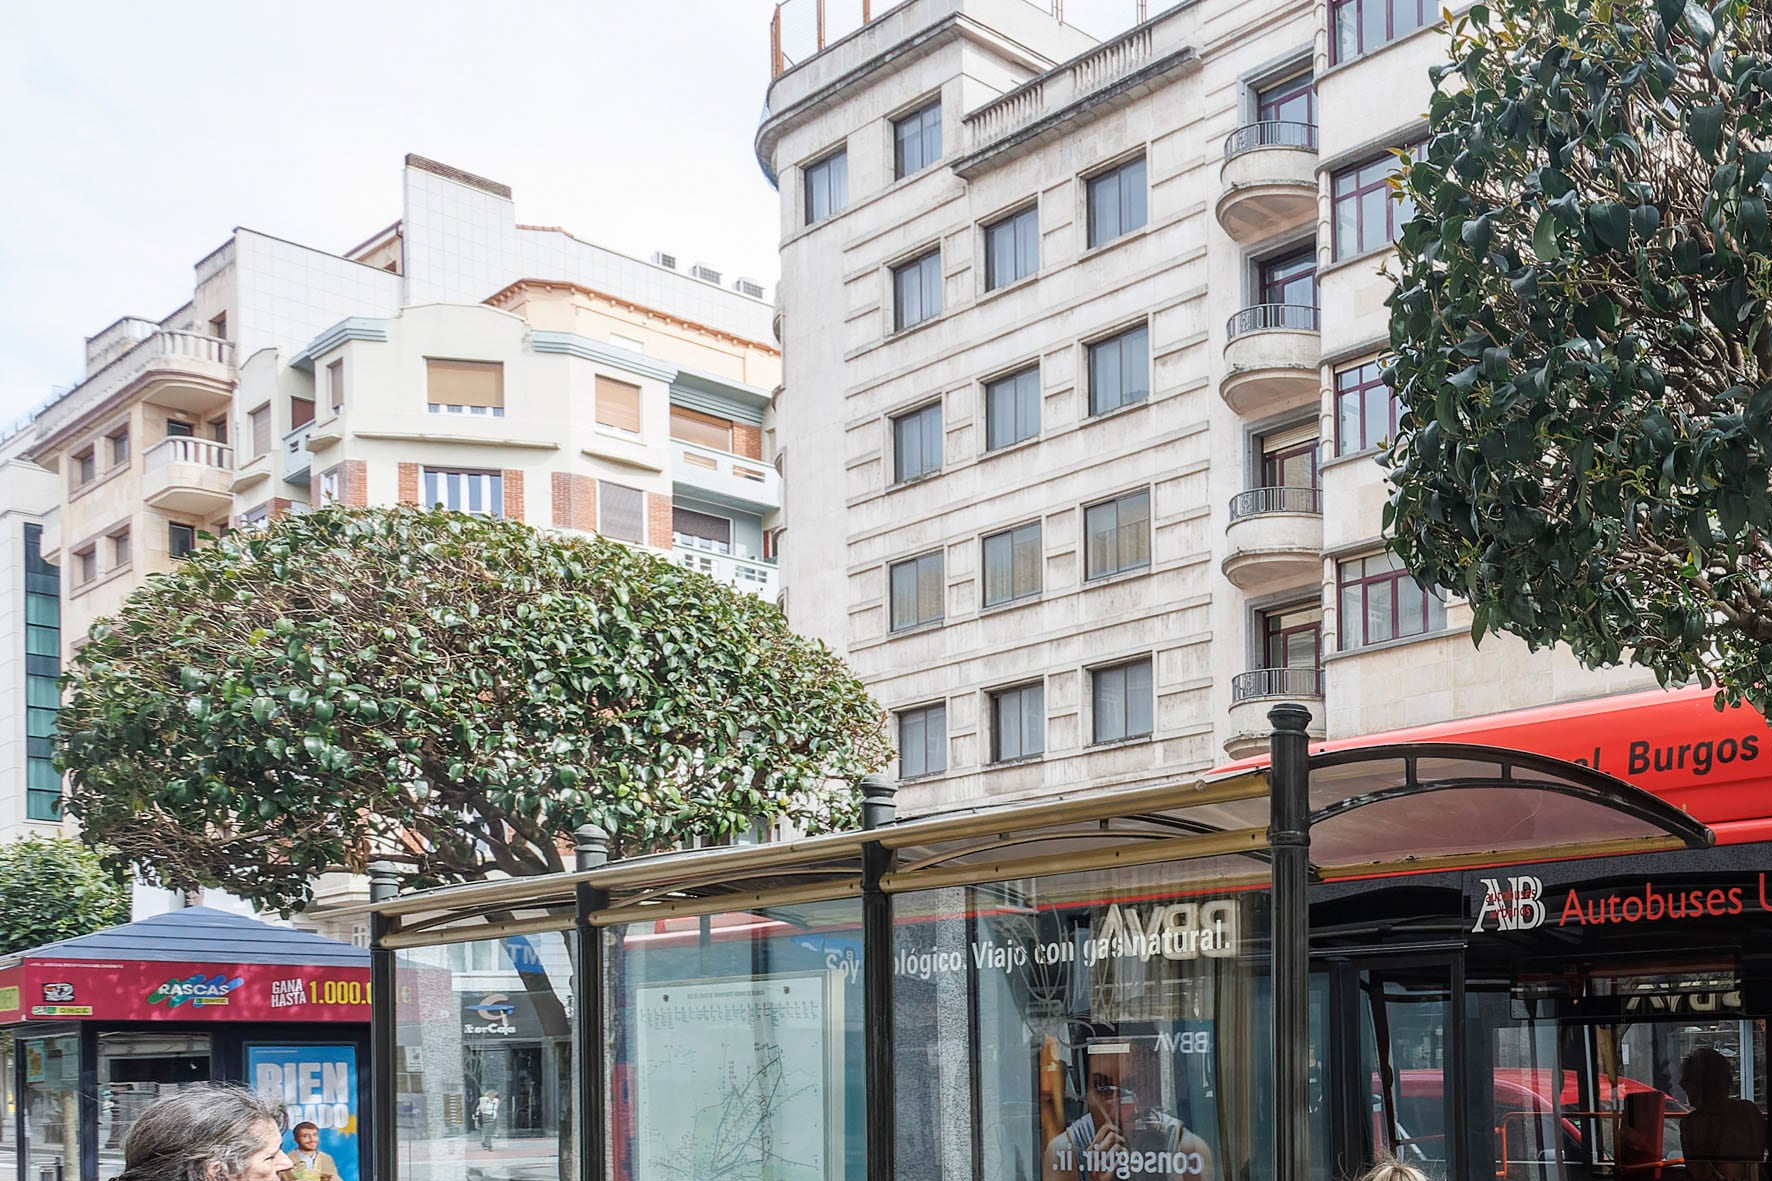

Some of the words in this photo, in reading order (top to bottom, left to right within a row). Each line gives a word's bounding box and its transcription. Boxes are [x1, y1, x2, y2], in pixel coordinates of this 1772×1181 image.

[1628, 733, 1759, 777] Burgos
[1559, 881, 1744, 927] Autobuses
[971, 939, 1027, 976] Viajo
[1034, 936, 1076, 965] con
[157, 982, 231, 997] RASCAS
[271, 978, 304, 995] GANA
[271, 991, 307, 1008] HASTA
[255, 1061, 350, 1105] BIEN
